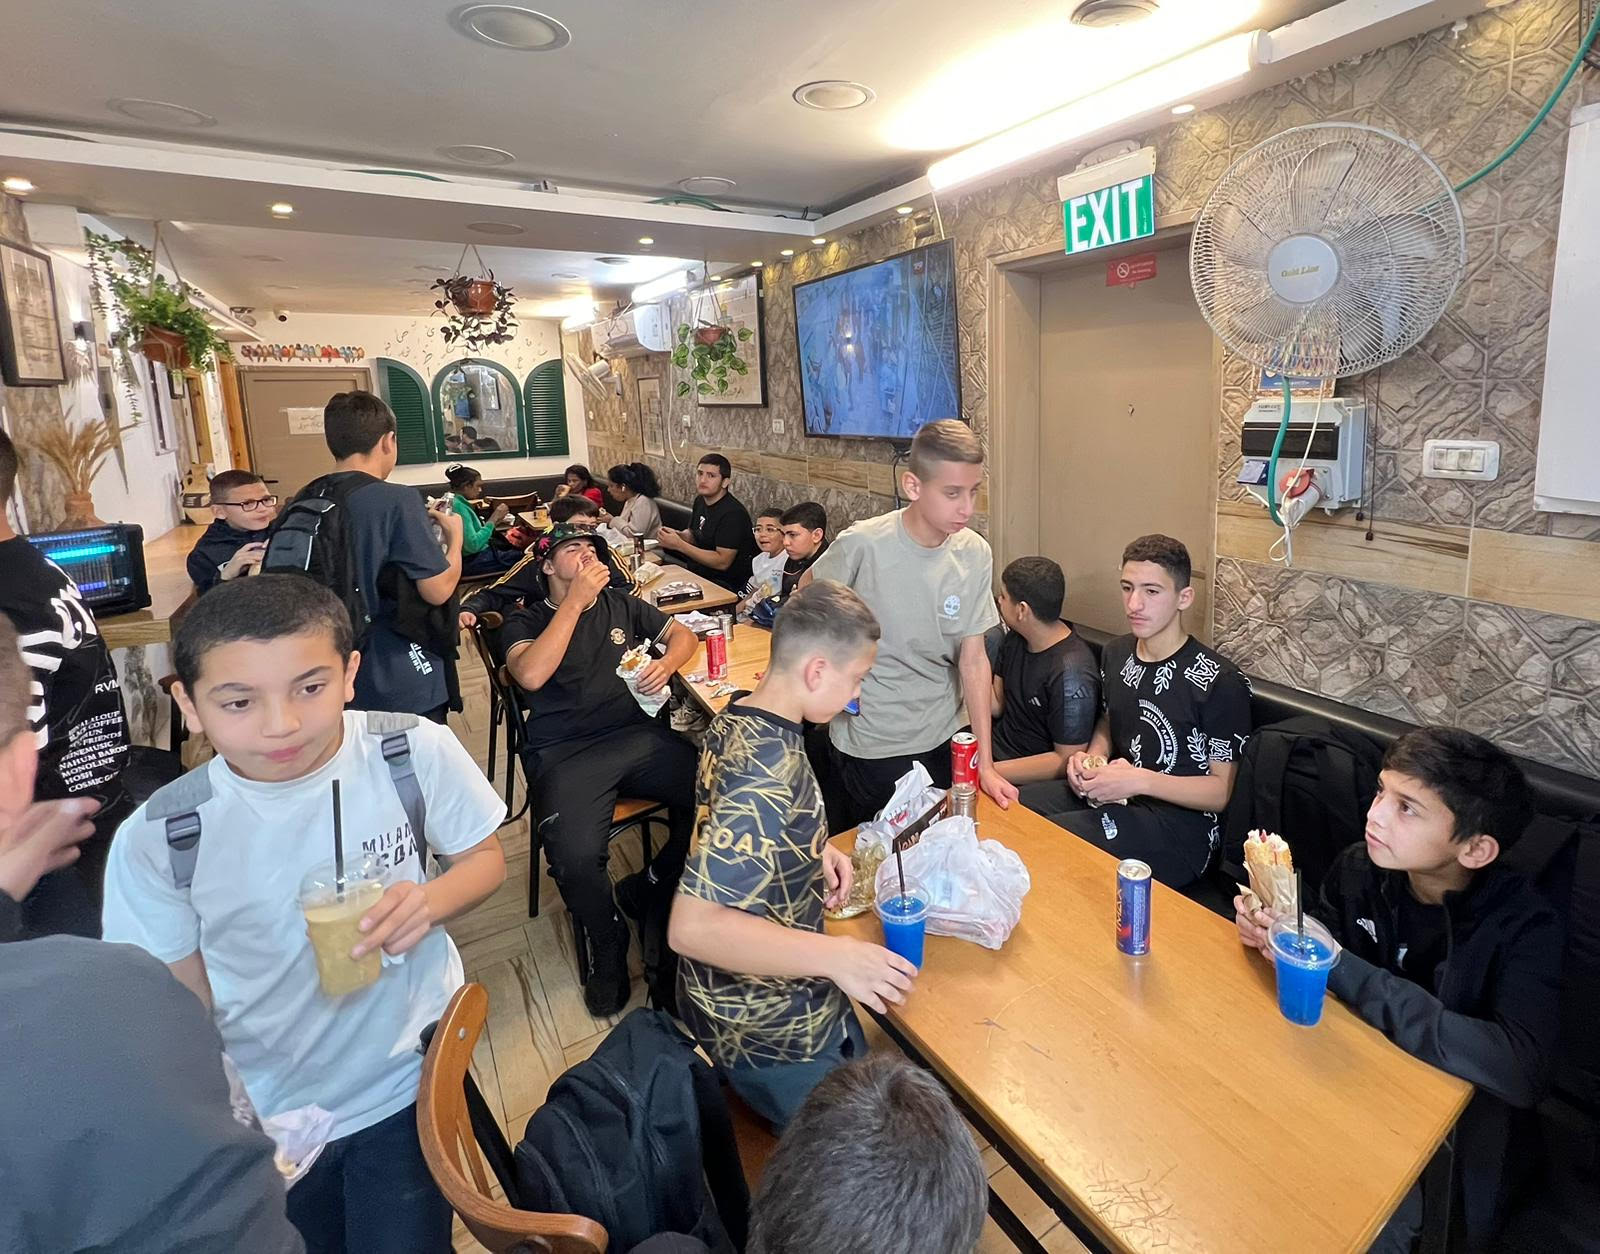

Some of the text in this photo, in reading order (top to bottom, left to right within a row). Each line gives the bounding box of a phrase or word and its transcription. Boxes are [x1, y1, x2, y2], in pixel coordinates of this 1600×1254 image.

[1070, 179, 1143, 252] EXIT
[88, 716, 123, 730] COFFEE
[83, 731, 122, 746] FRIENDS
[98, 744, 128, 759] BARON
[61, 756, 115, 778] MONOLINK
[68, 776, 104, 793] COSMIC
